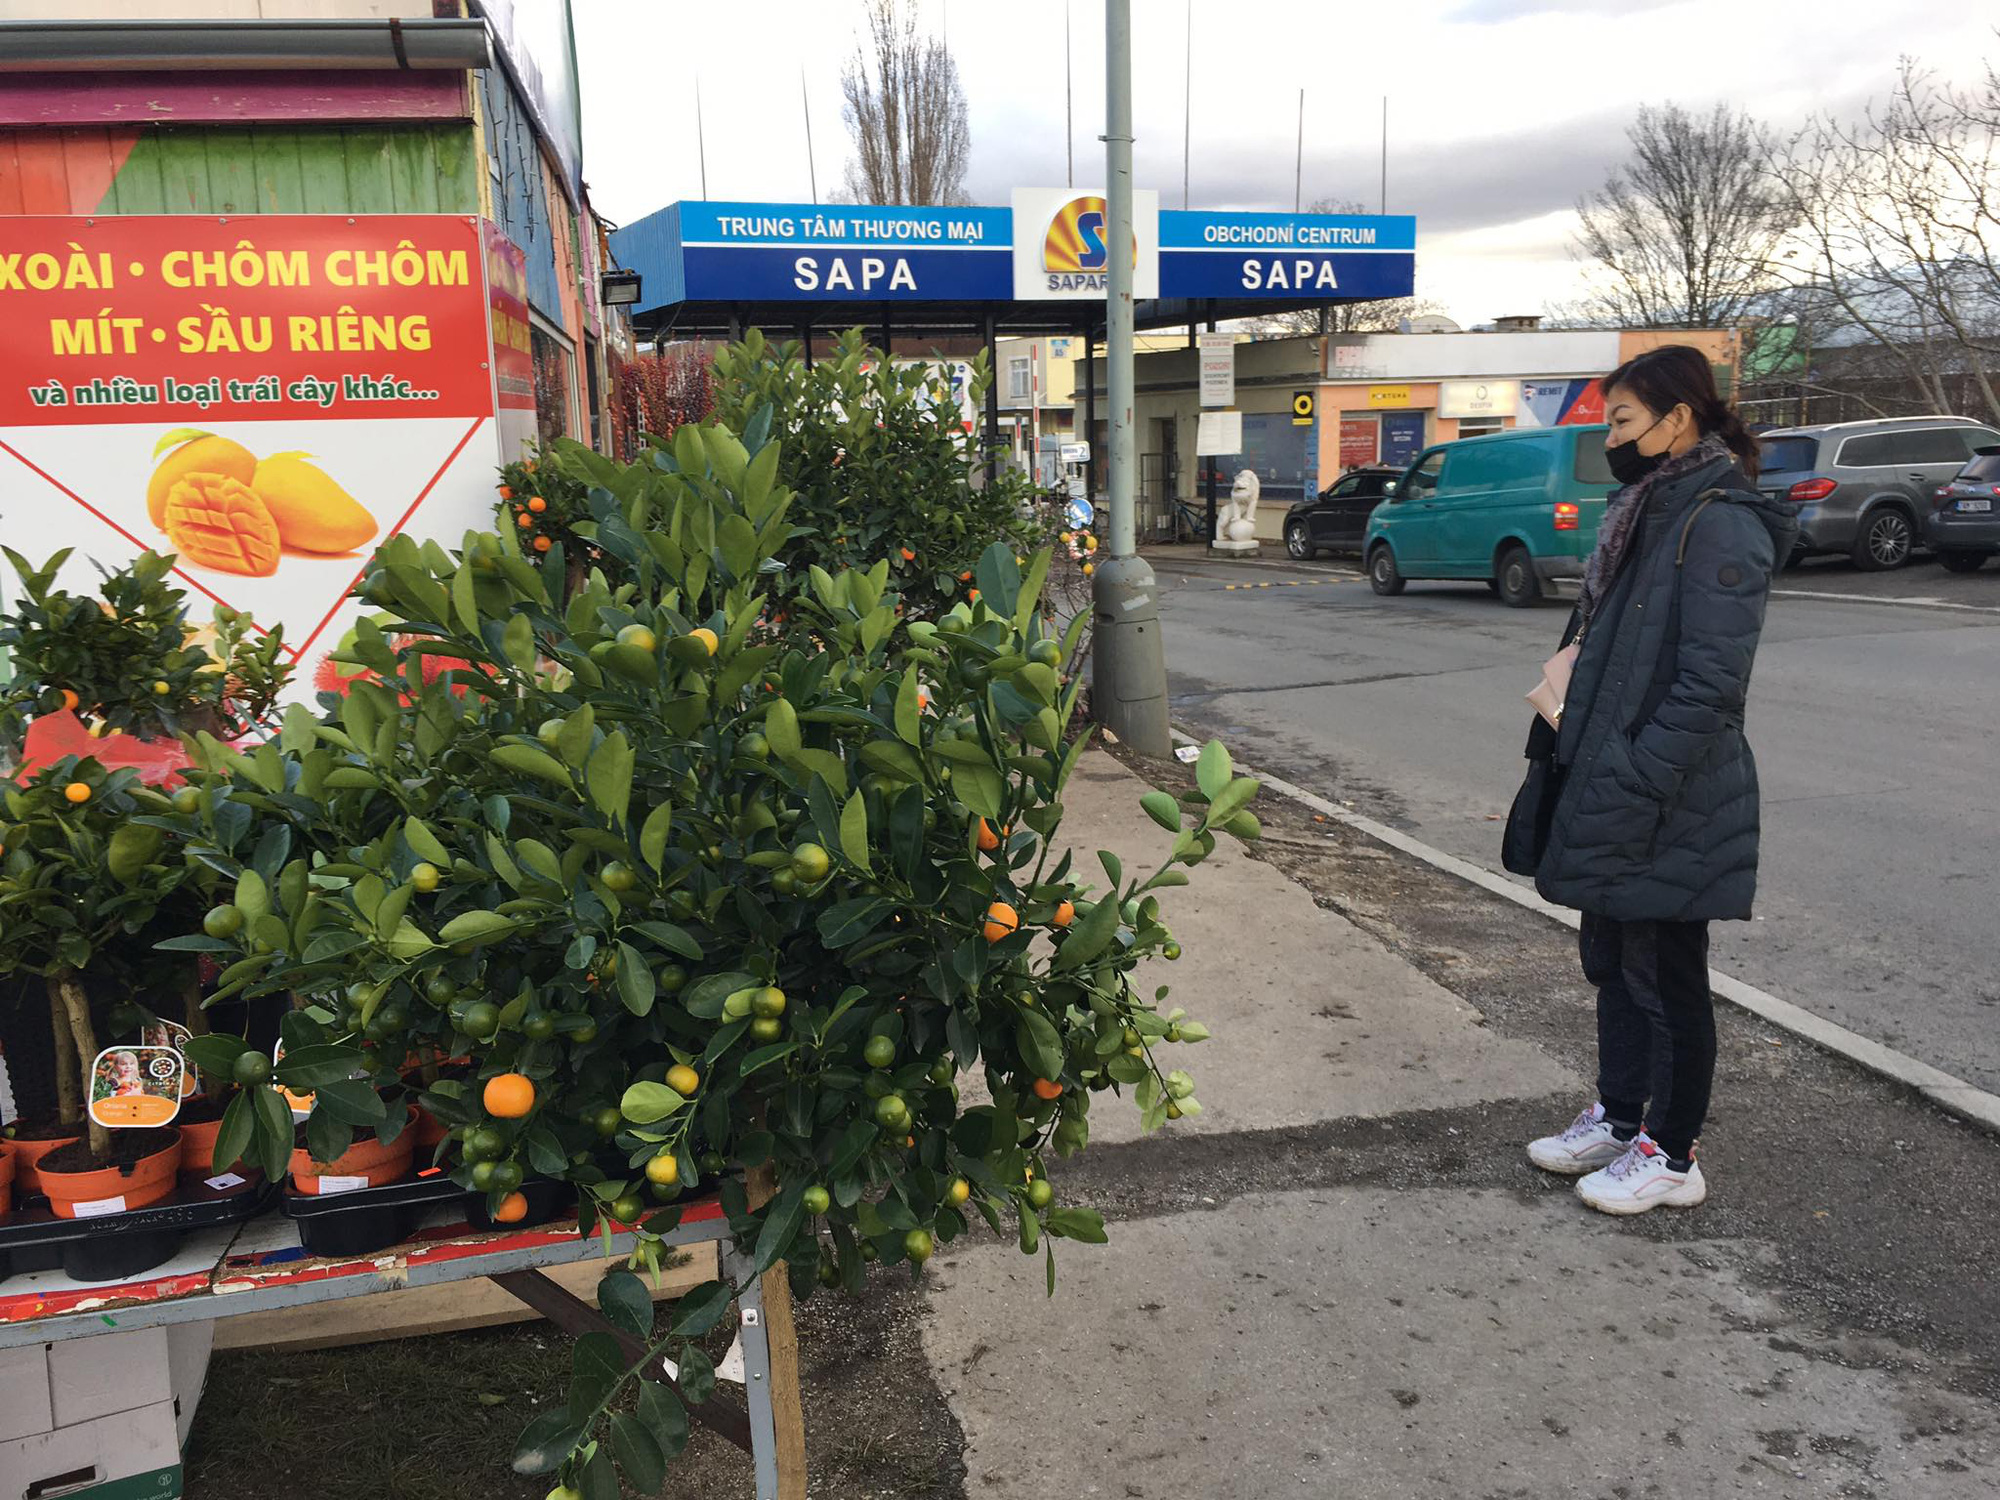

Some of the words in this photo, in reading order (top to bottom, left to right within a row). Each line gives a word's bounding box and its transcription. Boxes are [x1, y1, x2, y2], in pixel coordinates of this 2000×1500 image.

[717, 217, 795, 237] TRUNG
[801, 214, 845, 237] TÂM
[851, 219, 942, 239] THƯƠNG
[948, 222, 984, 244] MẠI
[1204, 223, 1294, 243] OBCHODNÍ
[1297, 227, 1376, 244] CENTRUM
[0, 242, 114, 290] XOÀI
[161, 240, 311, 287] CHÔM
[324, 240, 470, 286] CHÔM
[794, 256, 917, 290] SAPA
[1241, 259, 1338, 290] SAPA
[1048, 274, 1108, 291] SAPAR
[50, 307, 144, 355] MÍT
[177, 303, 273, 353] SẦU
[288, 305, 432, 352] RIÊNG
[29, 379, 67, 406] và
[74, 375, 158, 404] nhiều
[163, 376, 221, 409] loại
[228, 374, 282, 402] trái
[288, 374, 336, 408] cây
[342, 374, 439, 400] khác...
